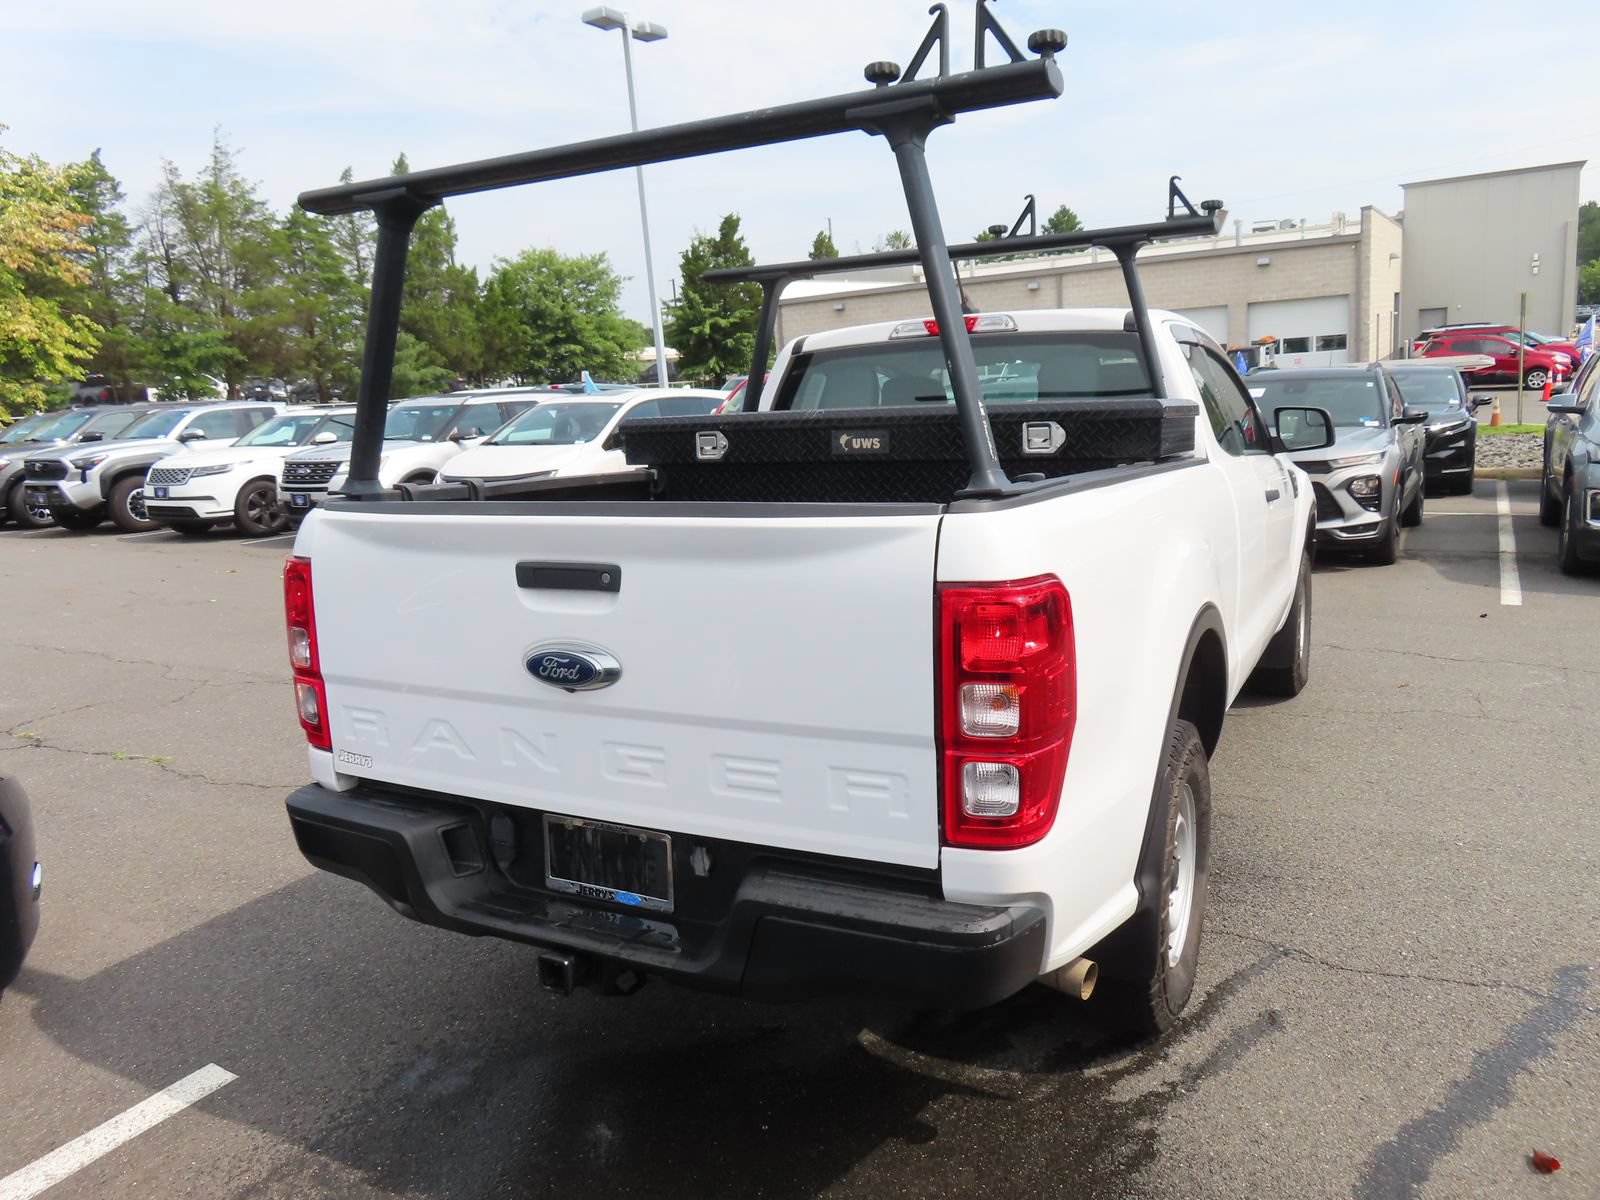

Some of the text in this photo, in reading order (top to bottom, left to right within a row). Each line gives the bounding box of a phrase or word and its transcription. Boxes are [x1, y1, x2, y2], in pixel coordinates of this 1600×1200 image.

[852, 438, 881, 449] UWS
[539, 656, 580, 680] Ford
[342, 704, 910, 820] RANGER
[576, 884, 615, 900] JERRY'S
